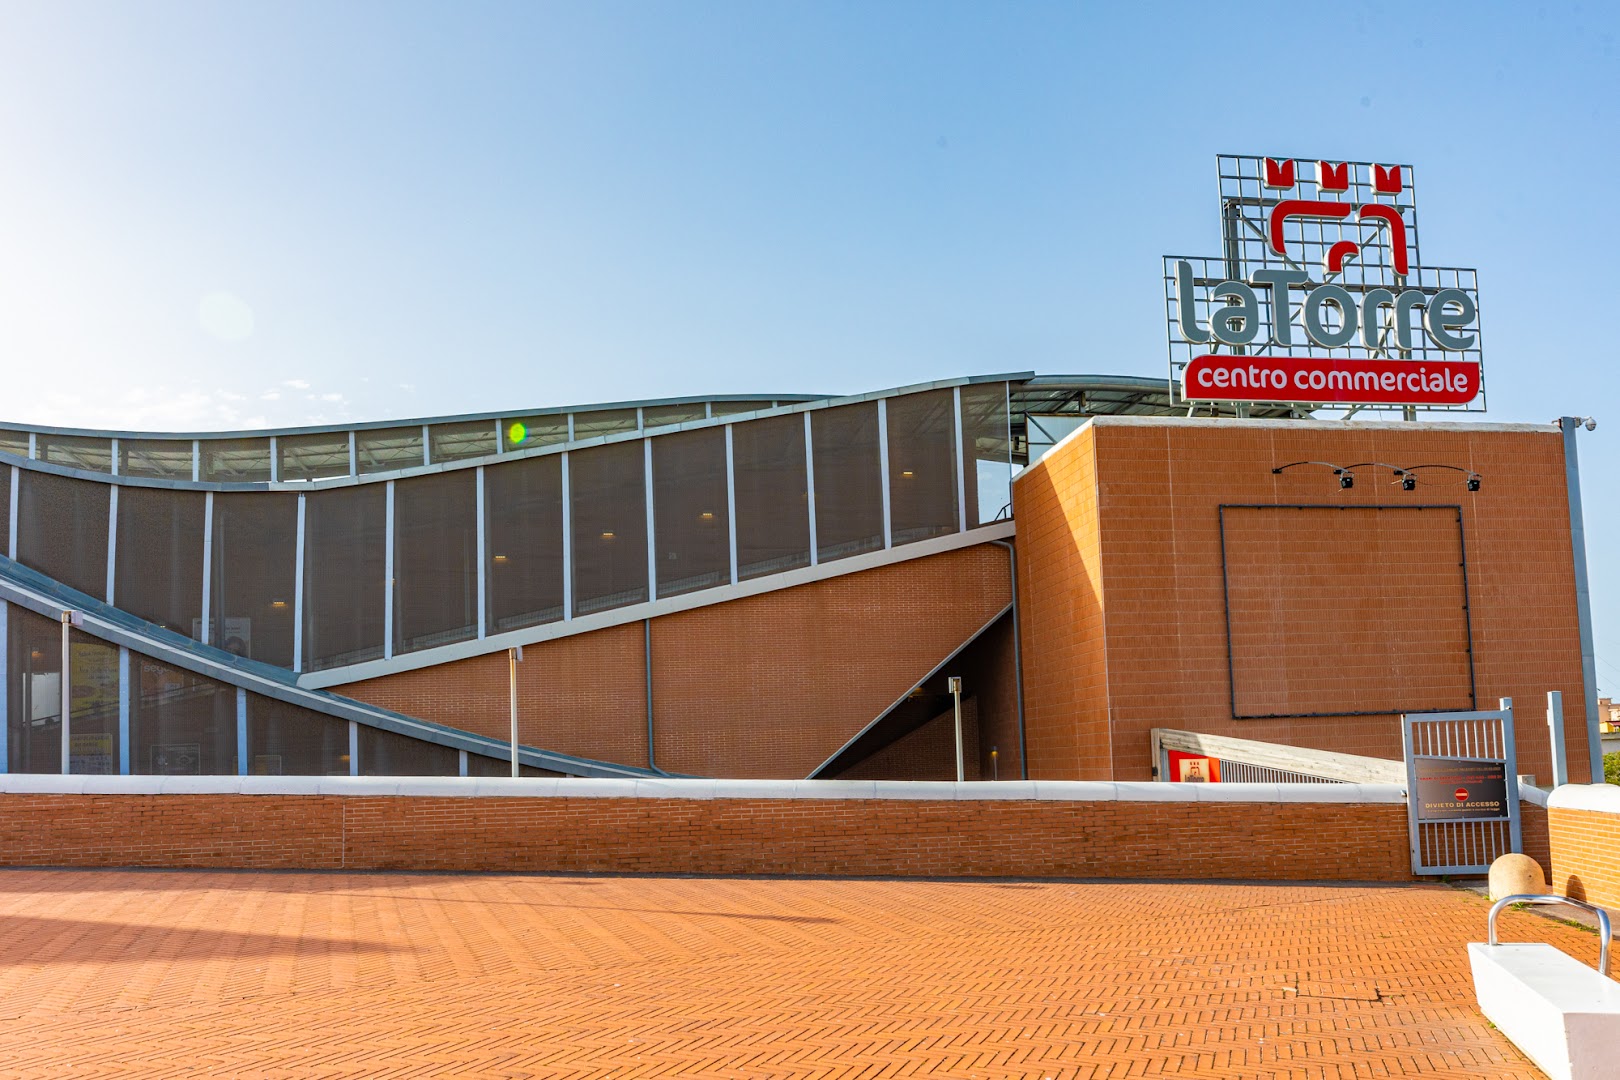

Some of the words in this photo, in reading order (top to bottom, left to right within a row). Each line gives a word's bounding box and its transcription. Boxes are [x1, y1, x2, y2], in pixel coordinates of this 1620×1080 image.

[1174, 260, 1476, 351] laTorre
[1197, 364, 1287, 389] centro
[1294, 367, 1468, 393] commerciale
